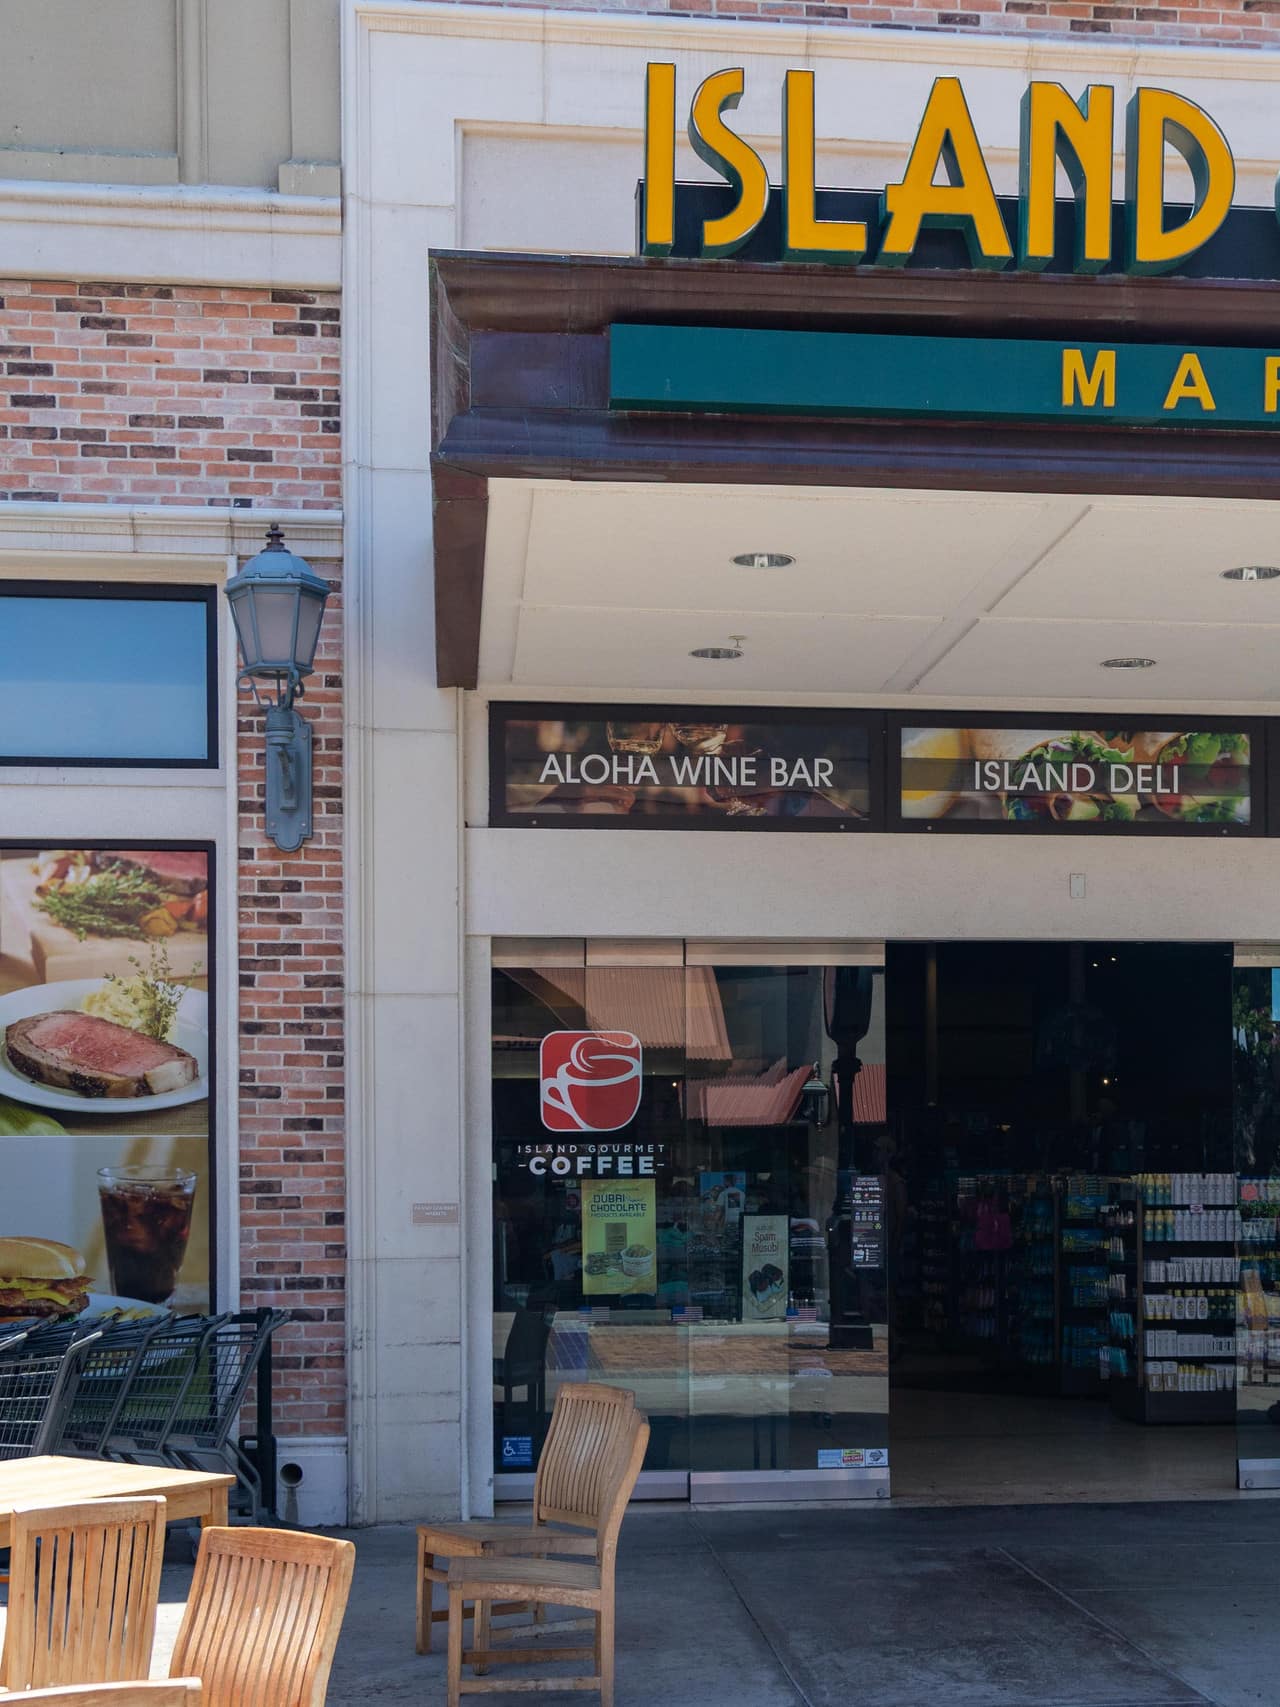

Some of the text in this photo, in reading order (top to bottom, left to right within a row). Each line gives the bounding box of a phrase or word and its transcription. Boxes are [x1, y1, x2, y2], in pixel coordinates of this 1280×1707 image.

[642, 60, 1236, 270] ISLAND
[538, 753, 834, 788] ALOHA WINE BAR
[973, 760, 1180, 794] ISLAND DELI
[517, 1144, 665, 1153] ISLAND GOURMET
[529, 1156, 655, 1175] COFFEE
[593, 1193, 625, 1203] DUBAI
[590, 1203, 647, 1212] CHOCOLATE
[754, 1231, 777, 1243] Spam
